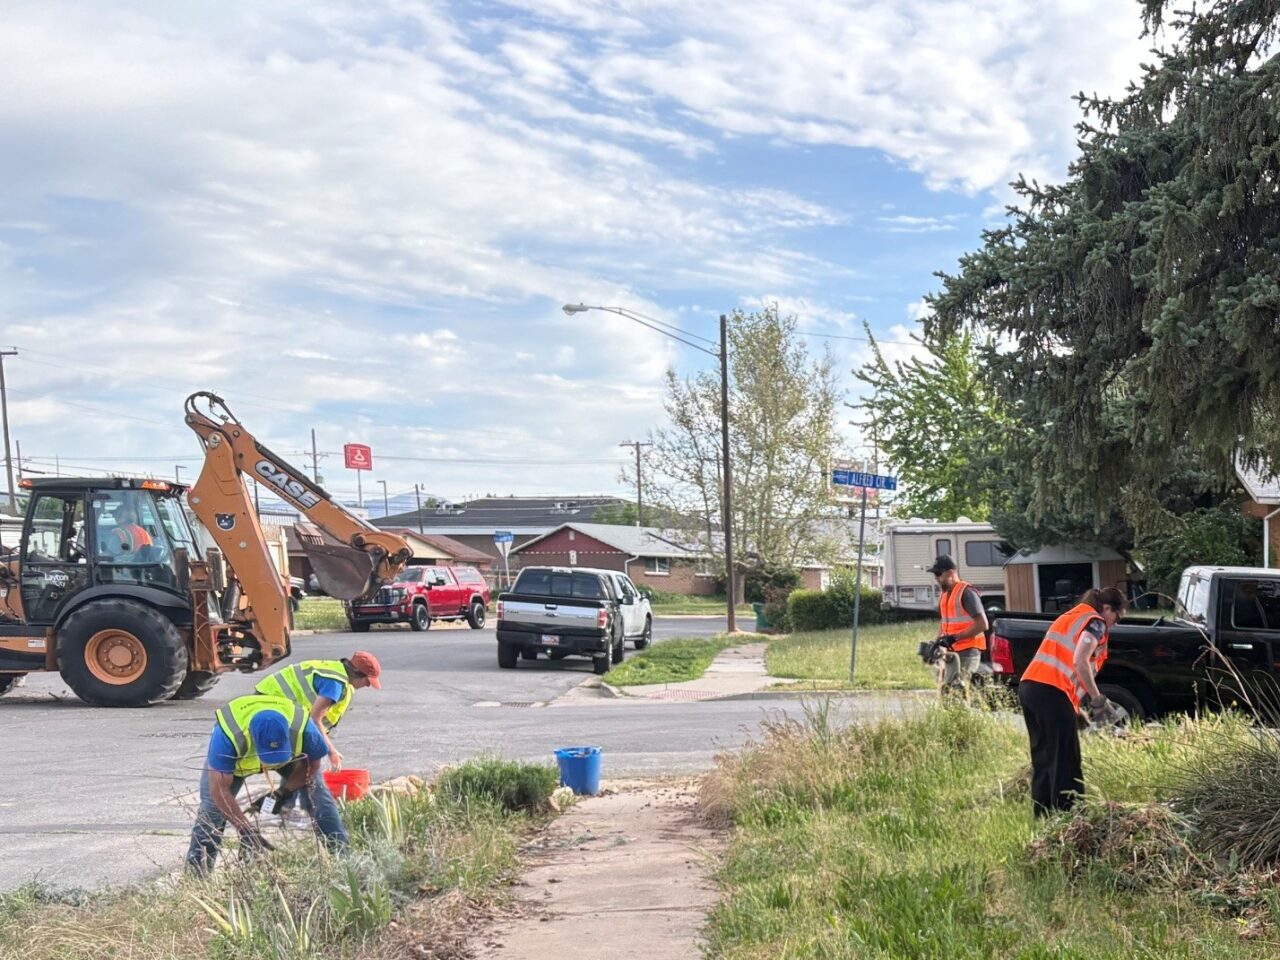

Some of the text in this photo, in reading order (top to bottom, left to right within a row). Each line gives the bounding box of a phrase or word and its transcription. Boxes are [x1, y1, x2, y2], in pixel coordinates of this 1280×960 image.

[255, 460, 321, 509] CASE
[851, 473, 874, 487] ALFRED
[44, 573, 69, 583] Layton
